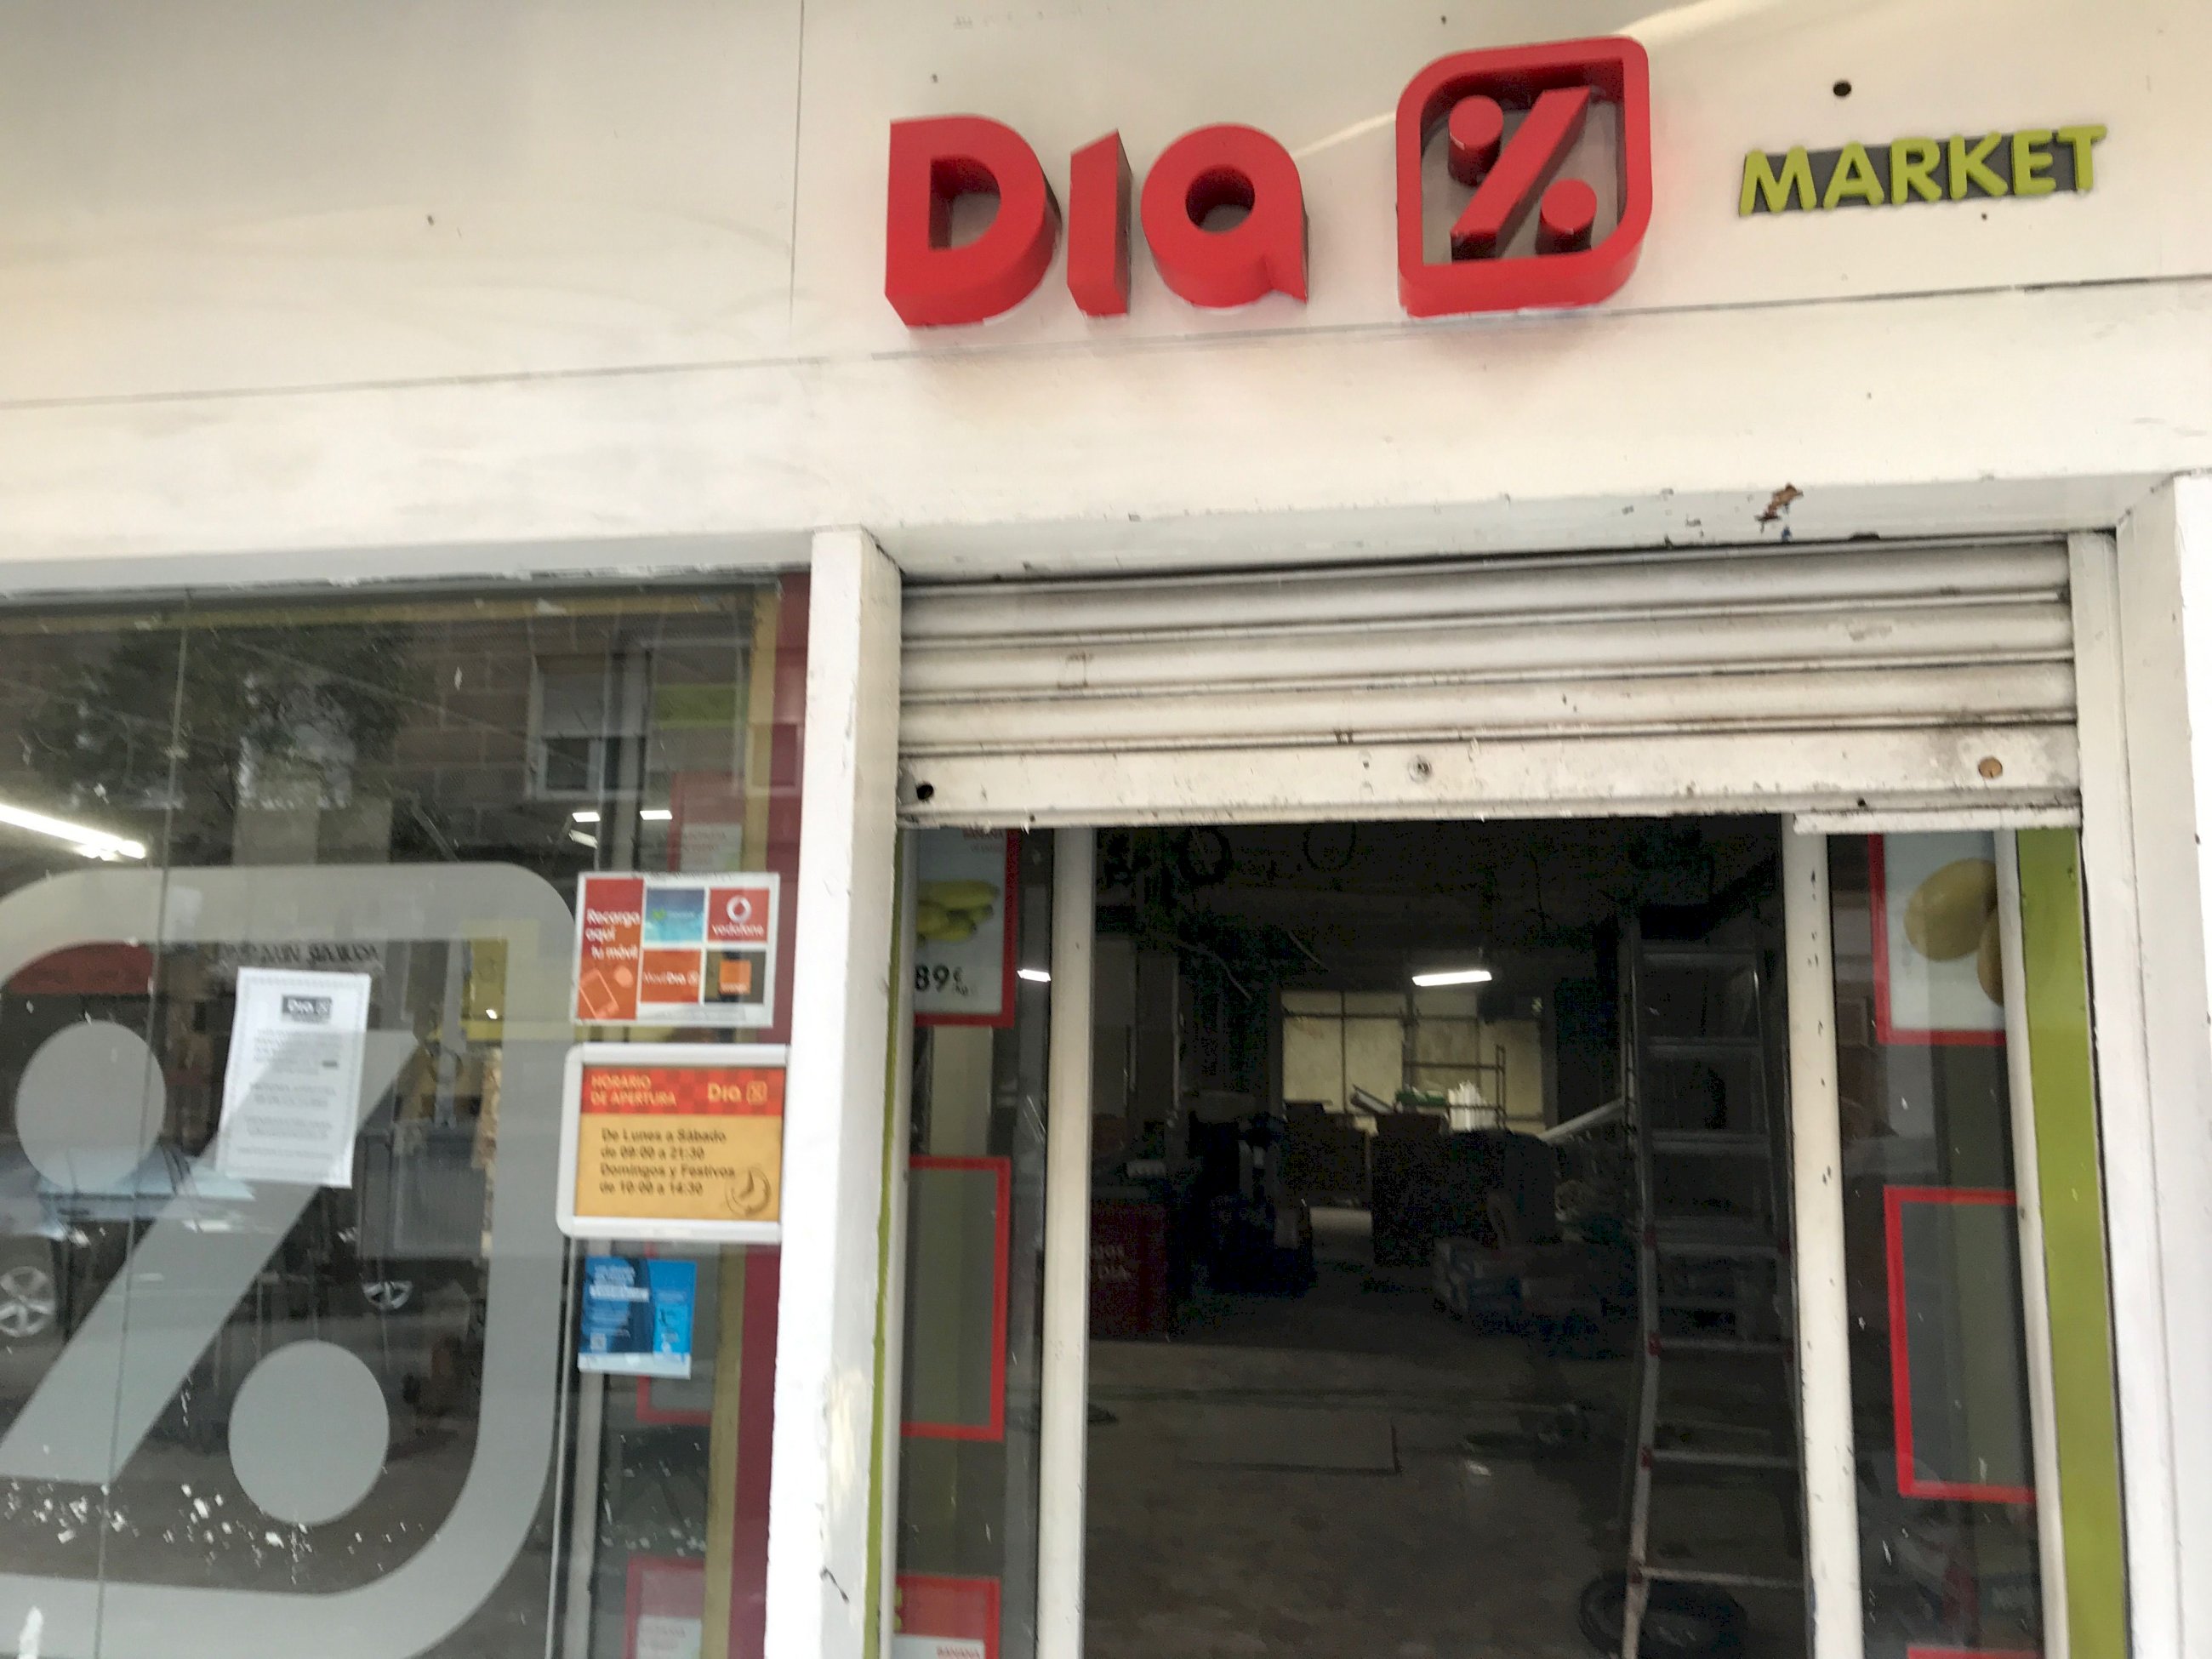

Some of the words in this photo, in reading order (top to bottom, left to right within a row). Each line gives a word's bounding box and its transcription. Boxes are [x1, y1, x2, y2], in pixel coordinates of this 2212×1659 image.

[1739, 124, 2108, 217] MARKET
[586, 908, 641, 928] Recarga
[711, 922, 765, 937] vodafone
[590, 1075, 652, 1091] HORARIO
[590, 1091, 607, 1105] DE
[611, 1091, 677, 1106] APERTURA
[601, 1127, 619, 1142] De
[622, 1128, 662, 1143] Lunes
[665, 1130, 674, 1142] a
[677, 1128, 727, 1143] Sábado
[600, 1146, 618, 1160] de
[658, 1149, 667, 1160] a
[670, 1146, 705, 1161] 21:30
[600, 1162, 666, 1180] Domingos
[669, 1165, 677, 1180] y
[681, 1164, 736, 1180] Festivos
[599, 1182, 616, 1196] de
[619, 1180, 654, 1196] 10:00
[656, 1183, 665, 1196] a
[670, 1181, 704, 1197] 14:30
